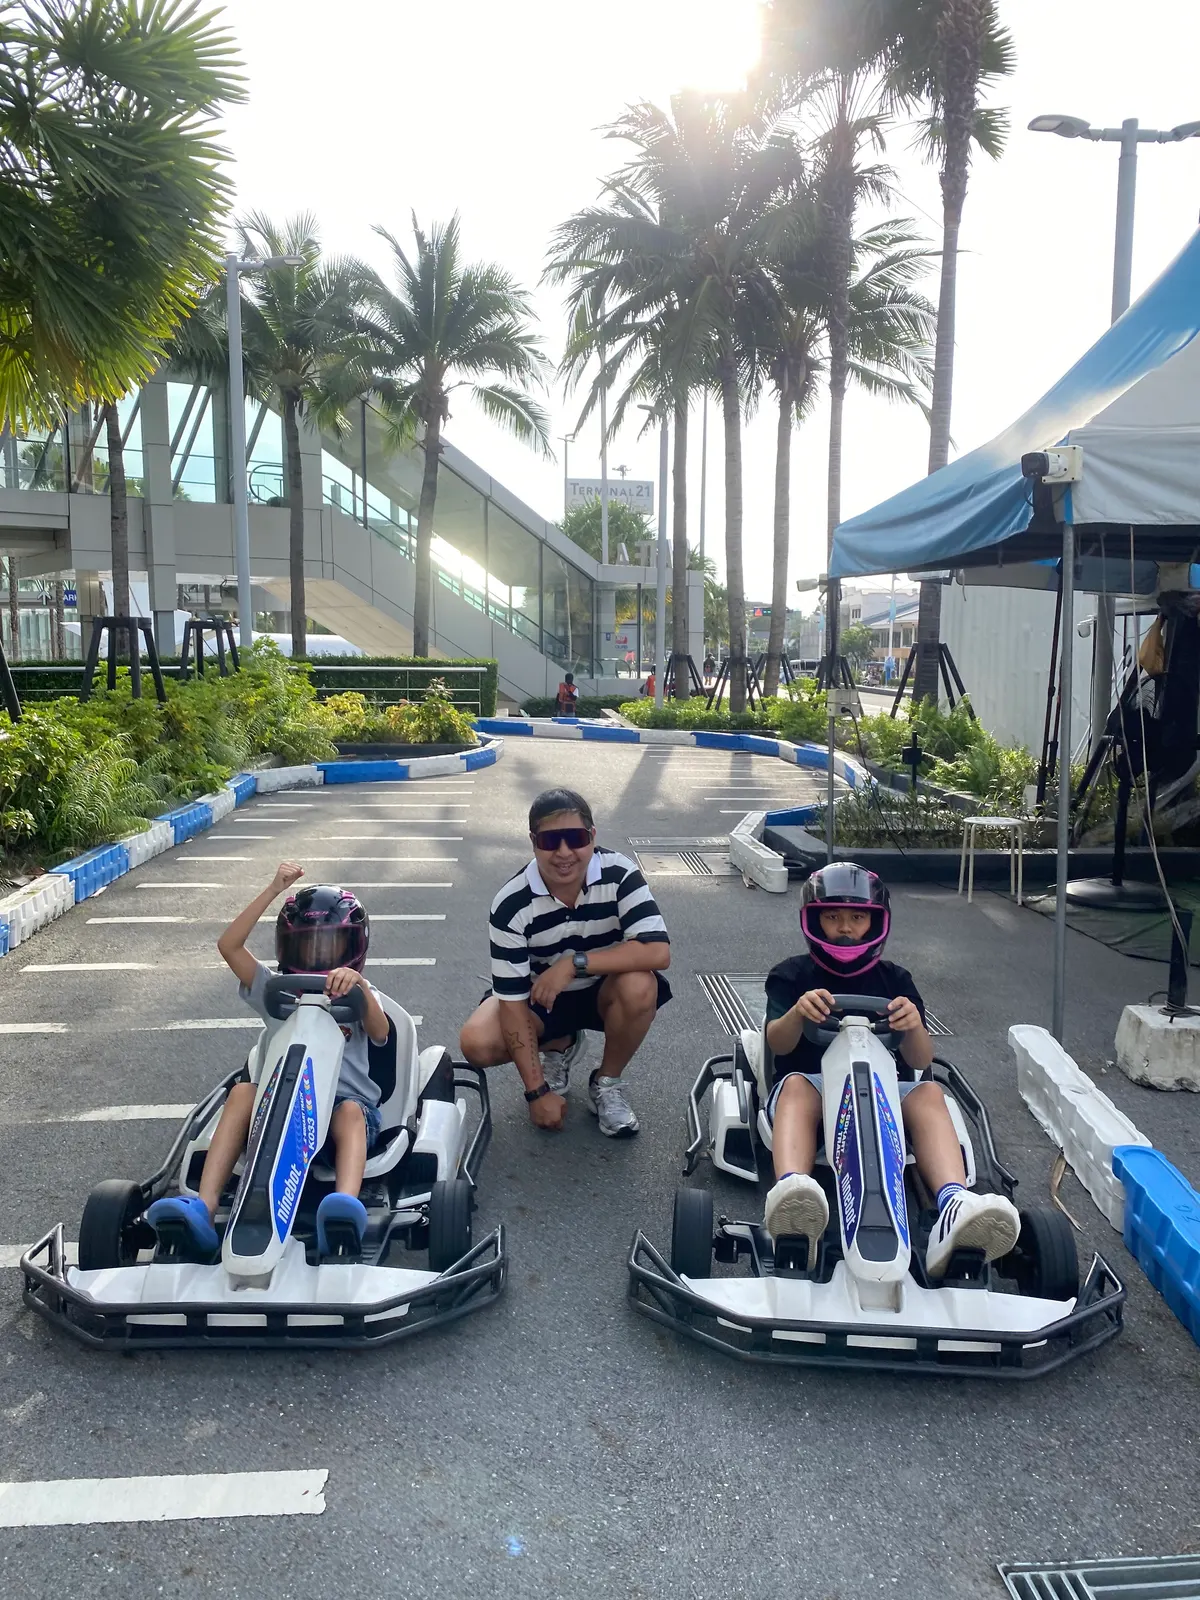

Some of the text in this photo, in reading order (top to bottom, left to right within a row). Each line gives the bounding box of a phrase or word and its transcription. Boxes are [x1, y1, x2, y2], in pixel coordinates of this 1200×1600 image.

[308, 1117, 316, 1151] K033
[276, 1163, 302, 1224] ninebot
[841, 1172, 857, 1231] ninebot
